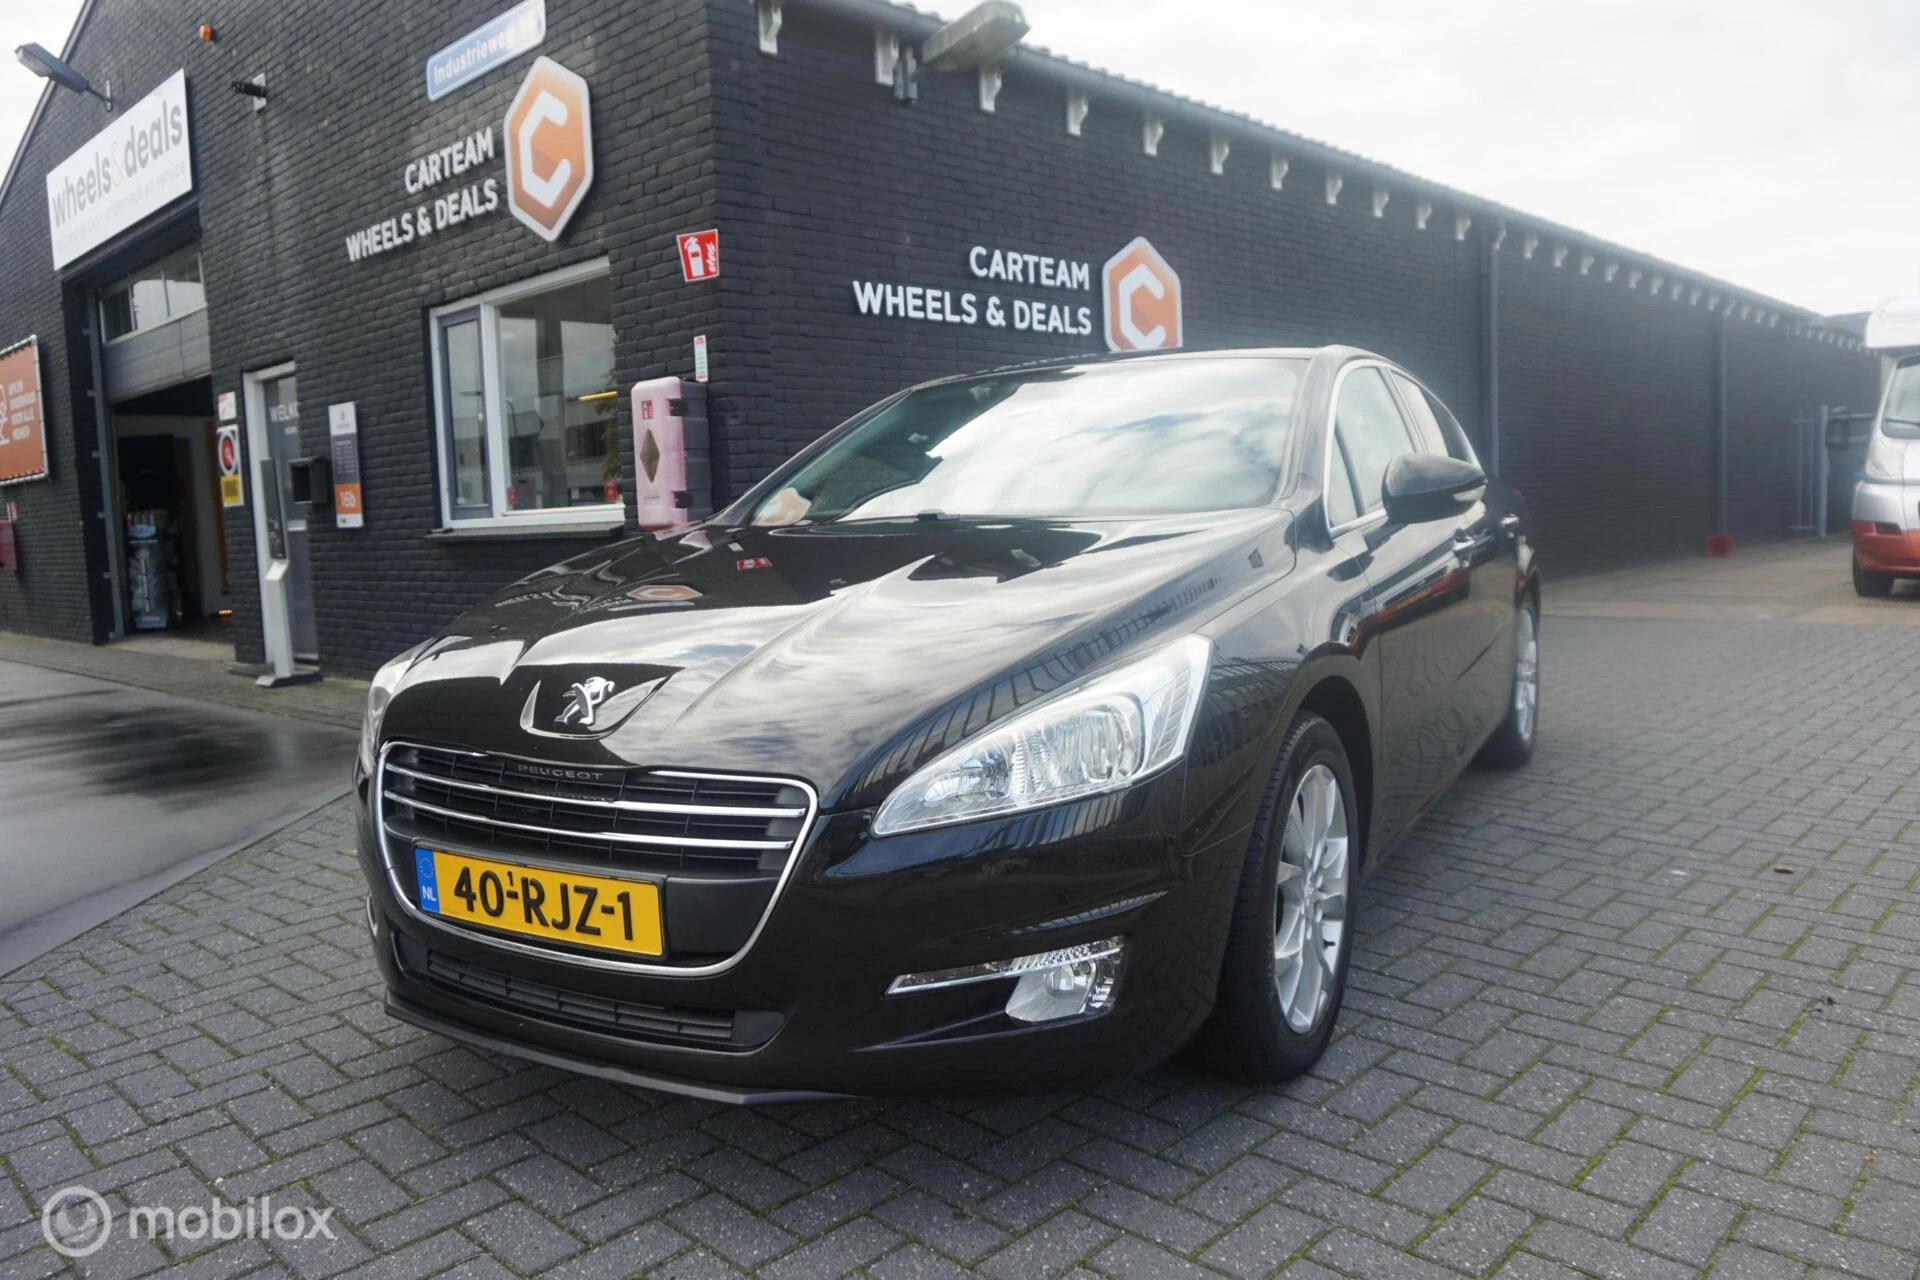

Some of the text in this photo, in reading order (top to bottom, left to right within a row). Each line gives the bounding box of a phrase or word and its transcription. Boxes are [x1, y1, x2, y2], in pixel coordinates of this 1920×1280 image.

[433, 26, 515, 85] Industrieweg
[404, 126, 494, 194] CARTEAM
[346, 178, 499, 262] WHEELS & DEALS
[969, 246, 1091, 291] CARTEAM
[852, 280, 1092, 336] WHEELS & DEALS
[518, 763, 603, 780] PEUGEOT
[422, 885, 436, 902] NL
